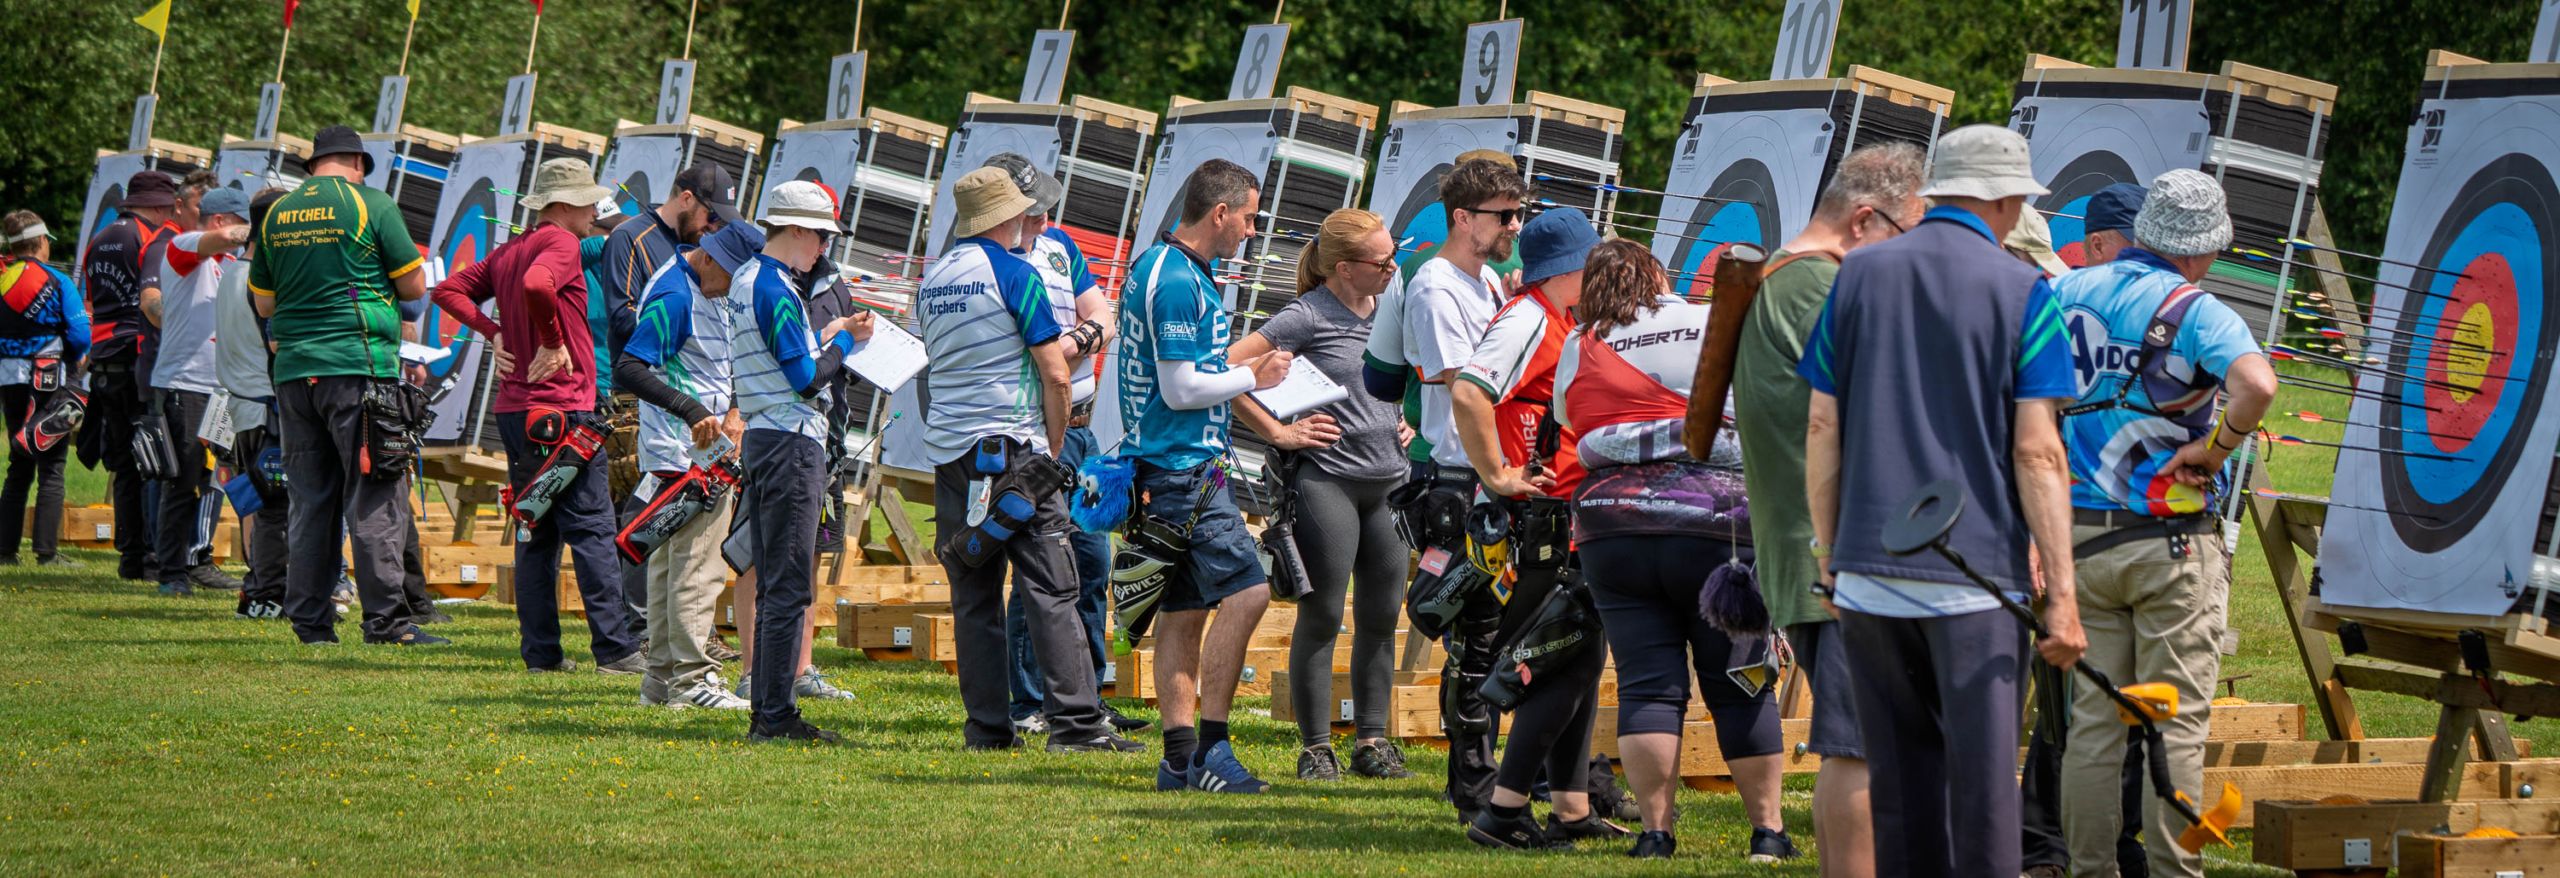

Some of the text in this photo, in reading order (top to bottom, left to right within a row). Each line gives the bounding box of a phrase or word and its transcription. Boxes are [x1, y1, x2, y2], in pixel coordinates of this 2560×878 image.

[1783, 0, 1831, 80] 10
[2129, 0, 2177, 67] 11
[837, 61, 852, 119] 6
[1033, 39, 1059, 102] 7
[1243, 32, 1270, 99] 8
[1475, 30, 1500, 105] 9
[260, 89, 274, 138] 2
[382, 82, 397, 132] 3
[508, 81, 525, 134] 4
[665, 67, 683, 124] 5
[138, 101, 148, 145] 1
[277, 207, 336, 225] MITCHELL
[273, 236, 339, 248] Archery Team
[928, 302, 967, 316] Archers
[528, 465, 559, 503] LEGEND
[645, 499, 686, 536] LEGEND
[1123, 572, 1165, 595] FIVICS
[1434, 560, 1475, 606] LEGEND
[1532, 629, 1583, 657] EASTON
